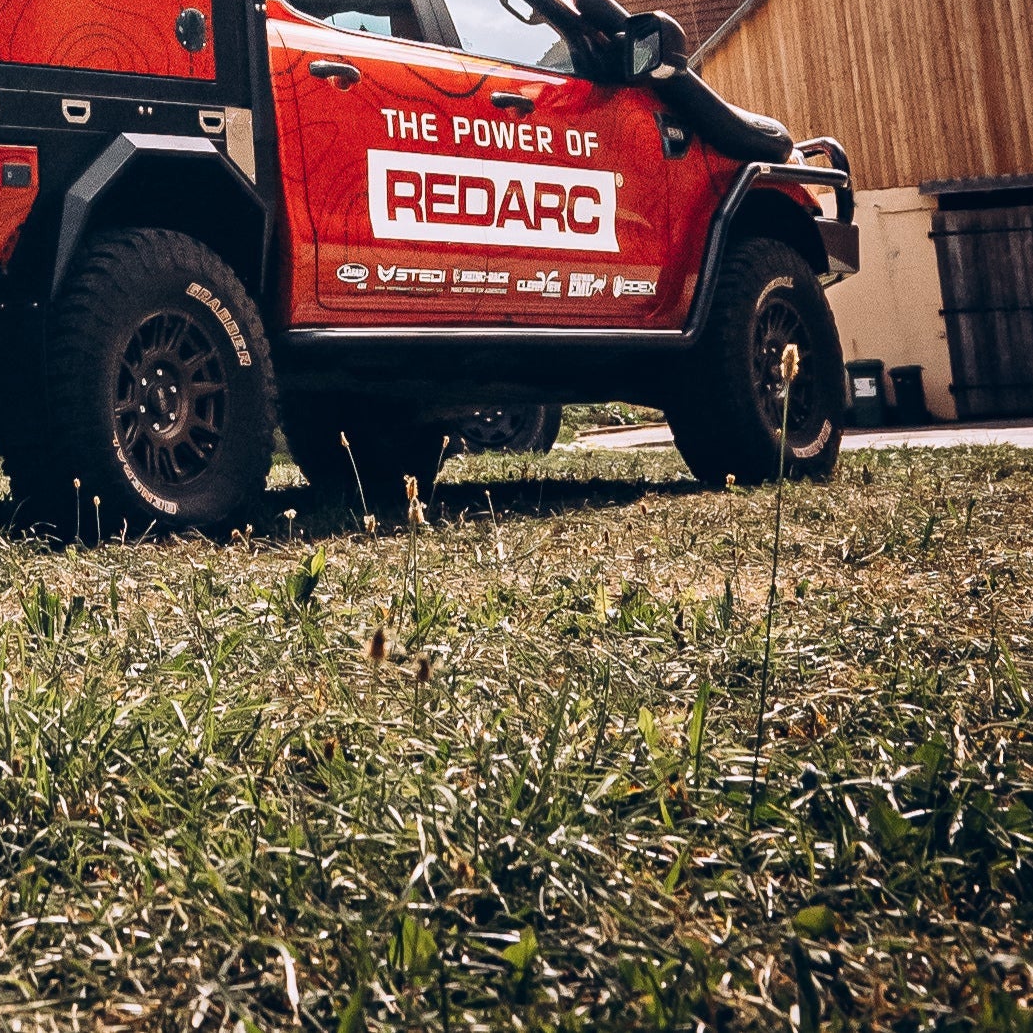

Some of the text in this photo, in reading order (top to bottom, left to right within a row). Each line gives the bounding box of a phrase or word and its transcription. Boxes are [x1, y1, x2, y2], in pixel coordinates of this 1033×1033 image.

[381, 108, 599, 157] THE POWER OF
[386, 168, 601, 235] REDARC
[185, 282, 252, 366] GRABBER
